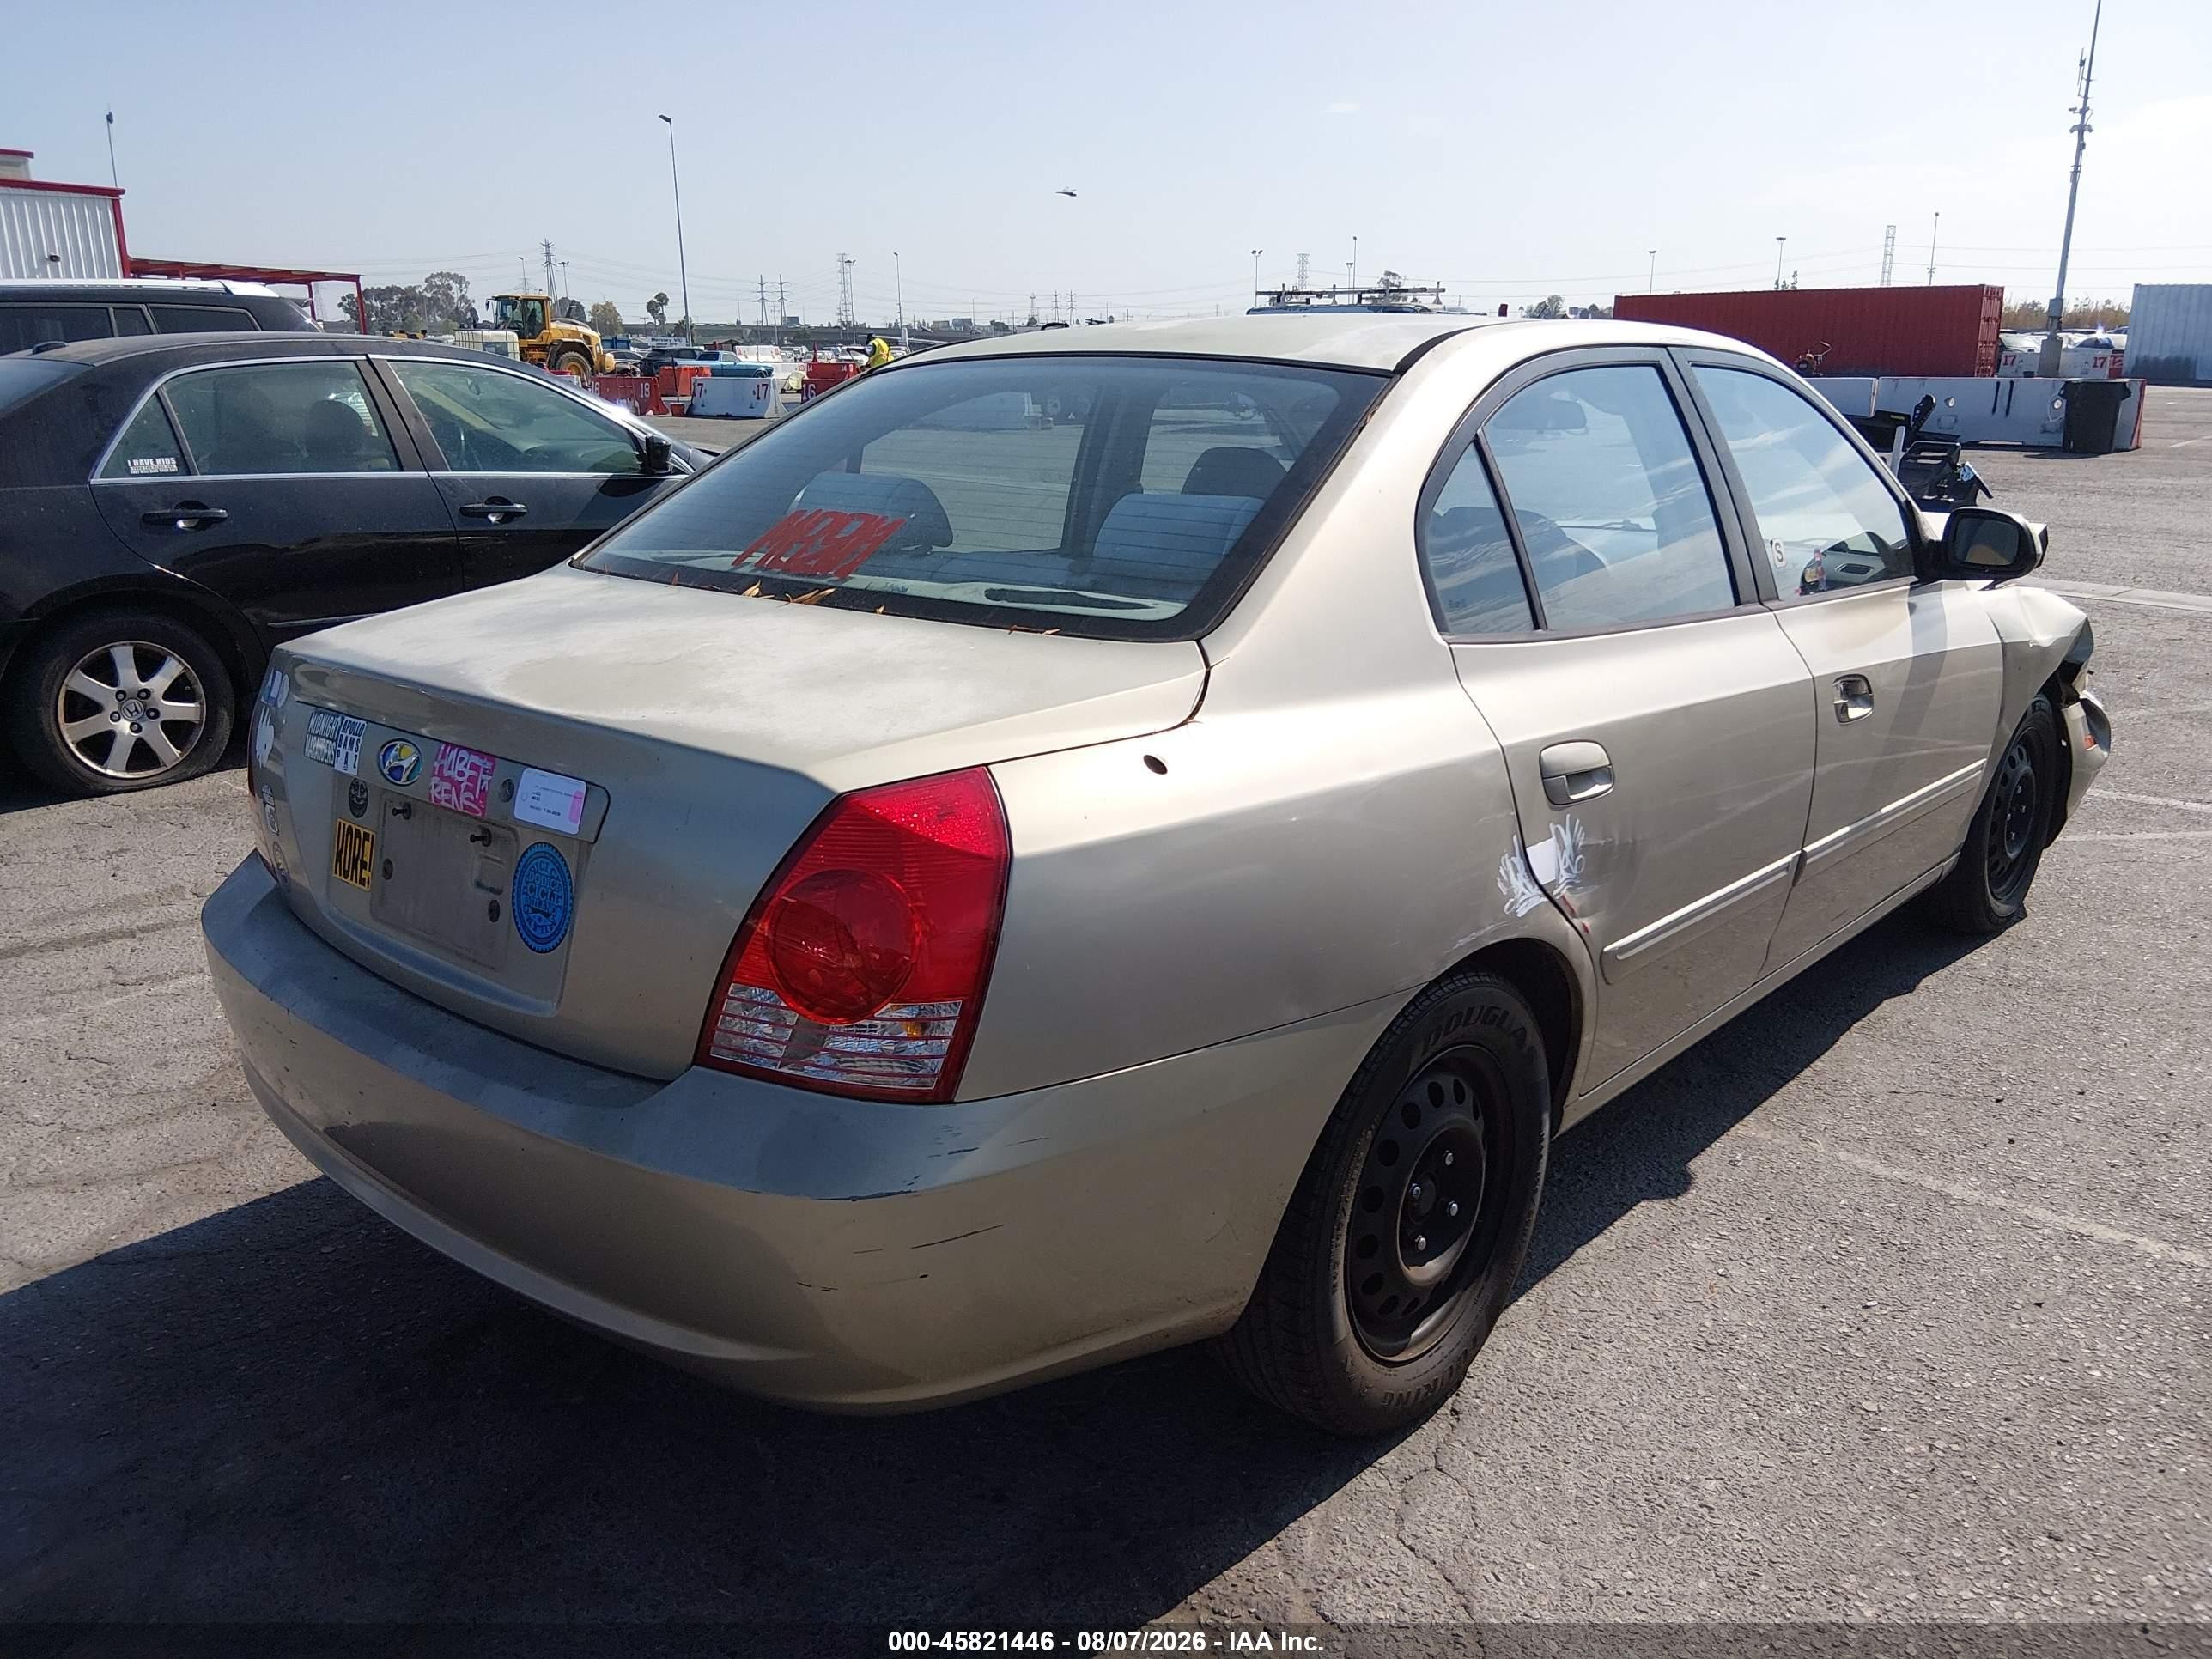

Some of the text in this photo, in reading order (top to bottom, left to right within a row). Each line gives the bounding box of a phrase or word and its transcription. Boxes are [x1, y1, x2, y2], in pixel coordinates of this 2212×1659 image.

[2003, 355, 2017, 366] 17
[2092, 356, 2108, 368] 17
[640, 382, 651, 398] 18
[756, 383, 769, 400] 17
[802, 383, 817, 403] 16
[1775, 543, 1784, 562] S
[342, 719, 366, 738] APOLLO
[334, 821, 374, 889] KORE!
